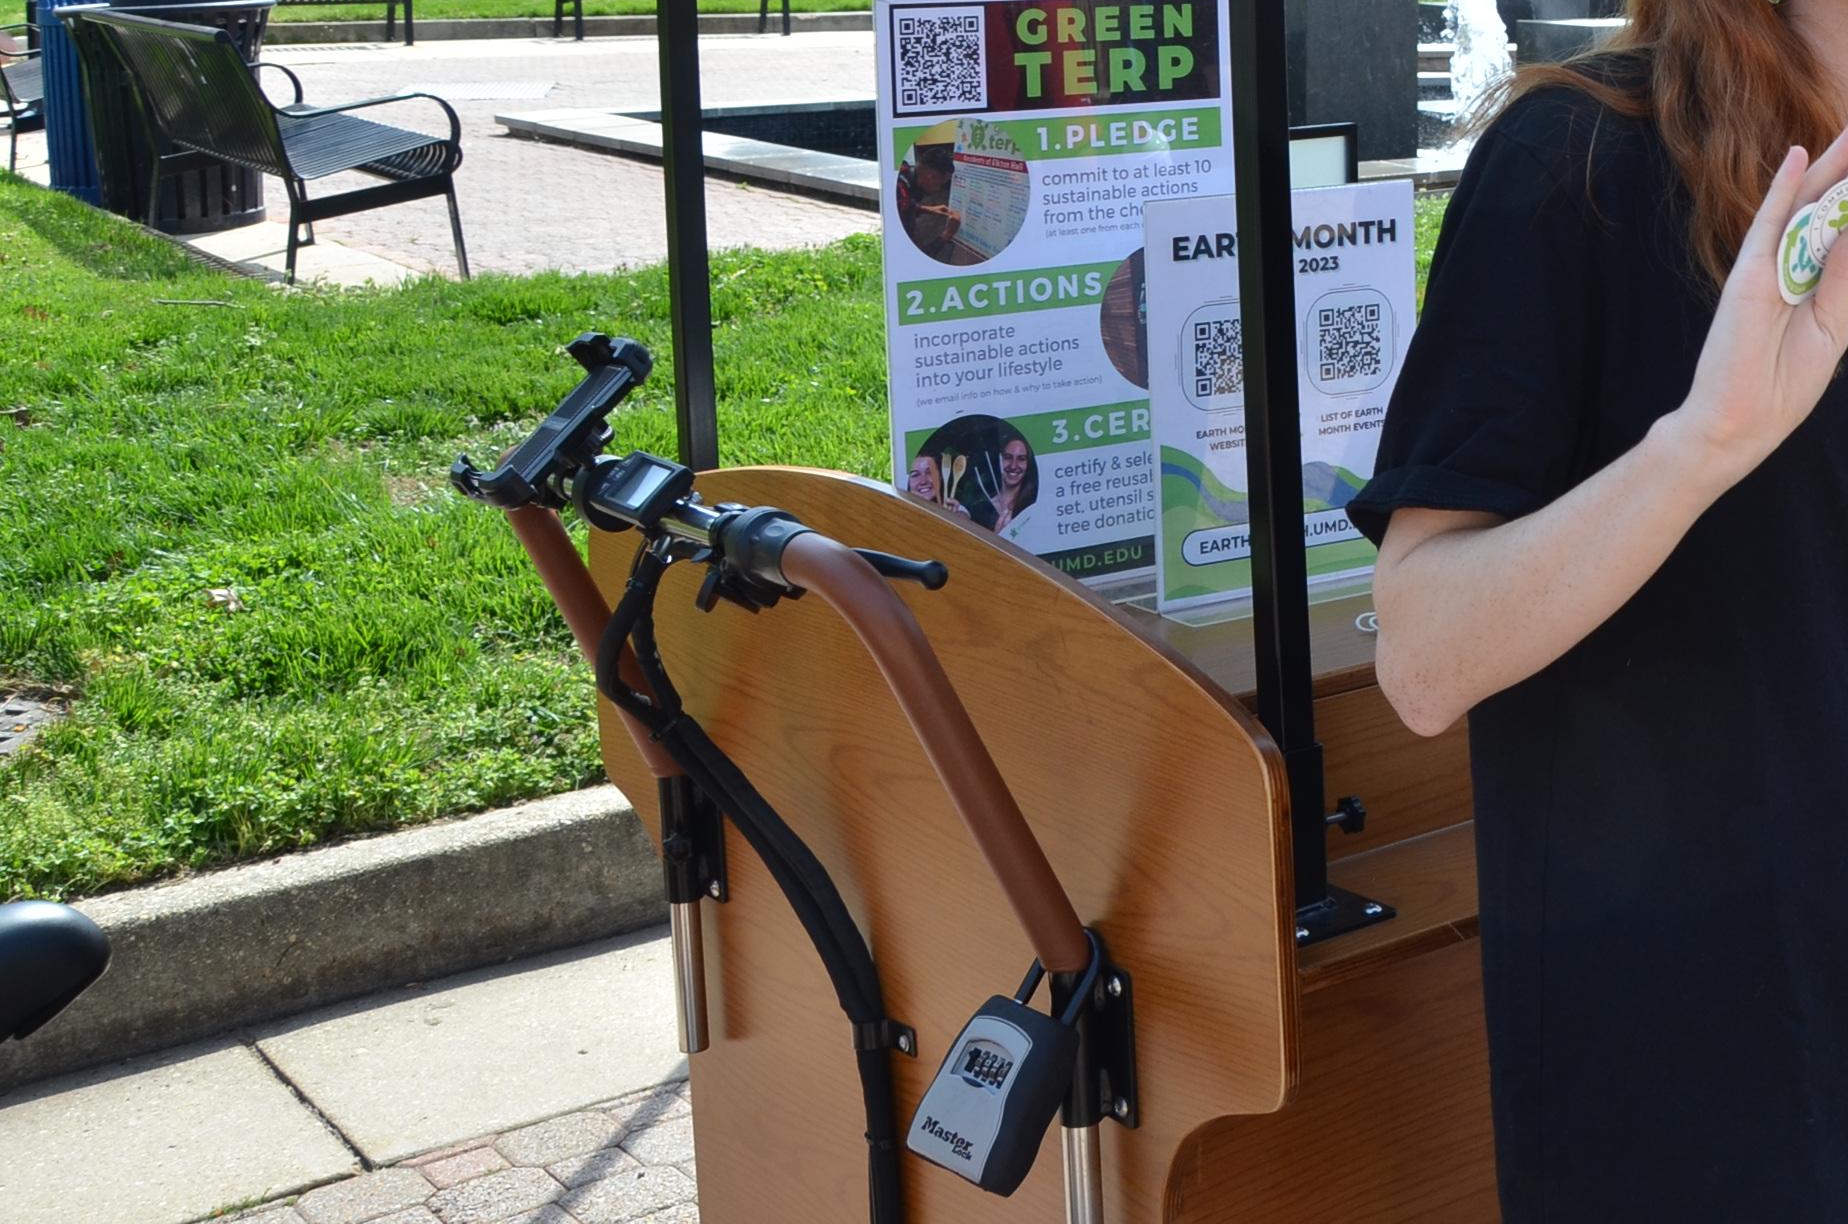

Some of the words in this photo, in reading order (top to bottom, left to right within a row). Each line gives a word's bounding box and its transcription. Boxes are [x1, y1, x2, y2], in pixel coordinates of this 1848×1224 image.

[1016, 3, 1194, 46] GREEN
[1013, 44, 1195, 98] TERP
[1036, 116, 1200, 152] 1.PLEDGE
[1042, 165, 1108, 187] commit
[1112, 166, 1129, 182] to
[1133, 165, 1149, 180] at
[1153, 160, 1191, 178] least
[1194, 159, 1212, 175] 10
[1042, 185, 1137, 206] sustainable
[1141, 180, 1199, 198] actions
[1043, 208, 1084, 225] from
[1087, 205, 1115, 222] the
[1097, 224, 1118, 233] from
[1119, 221, 1140, 231] each
[1172, 231, 1238, 262] EAR
[1291, 218, 1397, 251] MONTH
[1298, 255, 1340, 274] 2023
[905, 270, 1103, 317] 2.ACTIONS
[914, 324, 1016, 350] incorporate
[914, 342, 1014, 369] sustainable
[1018, 335, 1080, 356] actions
[916, 372, 951, 389] into
[954, 367, 993, 389] your
[997, 357, 1063, 378] lifestyle
[934, 392, 960, 404] email
[961, 391, 979, 401] info
[980, 390, 992, 399] on
[993, 387, 1013, 397] how
[1022, 383, 1041, 394] why
[1053, 379, 1072, 389] take
[1320, 411, 1340, 423] LIST
[1340, 410, 1353, 420] OF
[1354, 406, 1384, 418] EARTH
[1196, 426, 1228, 440] EARTH
[1318, 424, 1352, 436] MONTH
[1210, 438, 1247, 452] WEBSIT
[1054, 456, 1107, 479] certify
[1110, 457, 1122, 470] &
[1055, 486, 1065, 498] a
[1070, 481, 1102, 497] free
[1088, 488, 1142, 511] utensil
[1057, 519, 1090, 535] tree
[921, 1116, 974, 1151] Master
[952, 1144, 972, 1161] Lock
